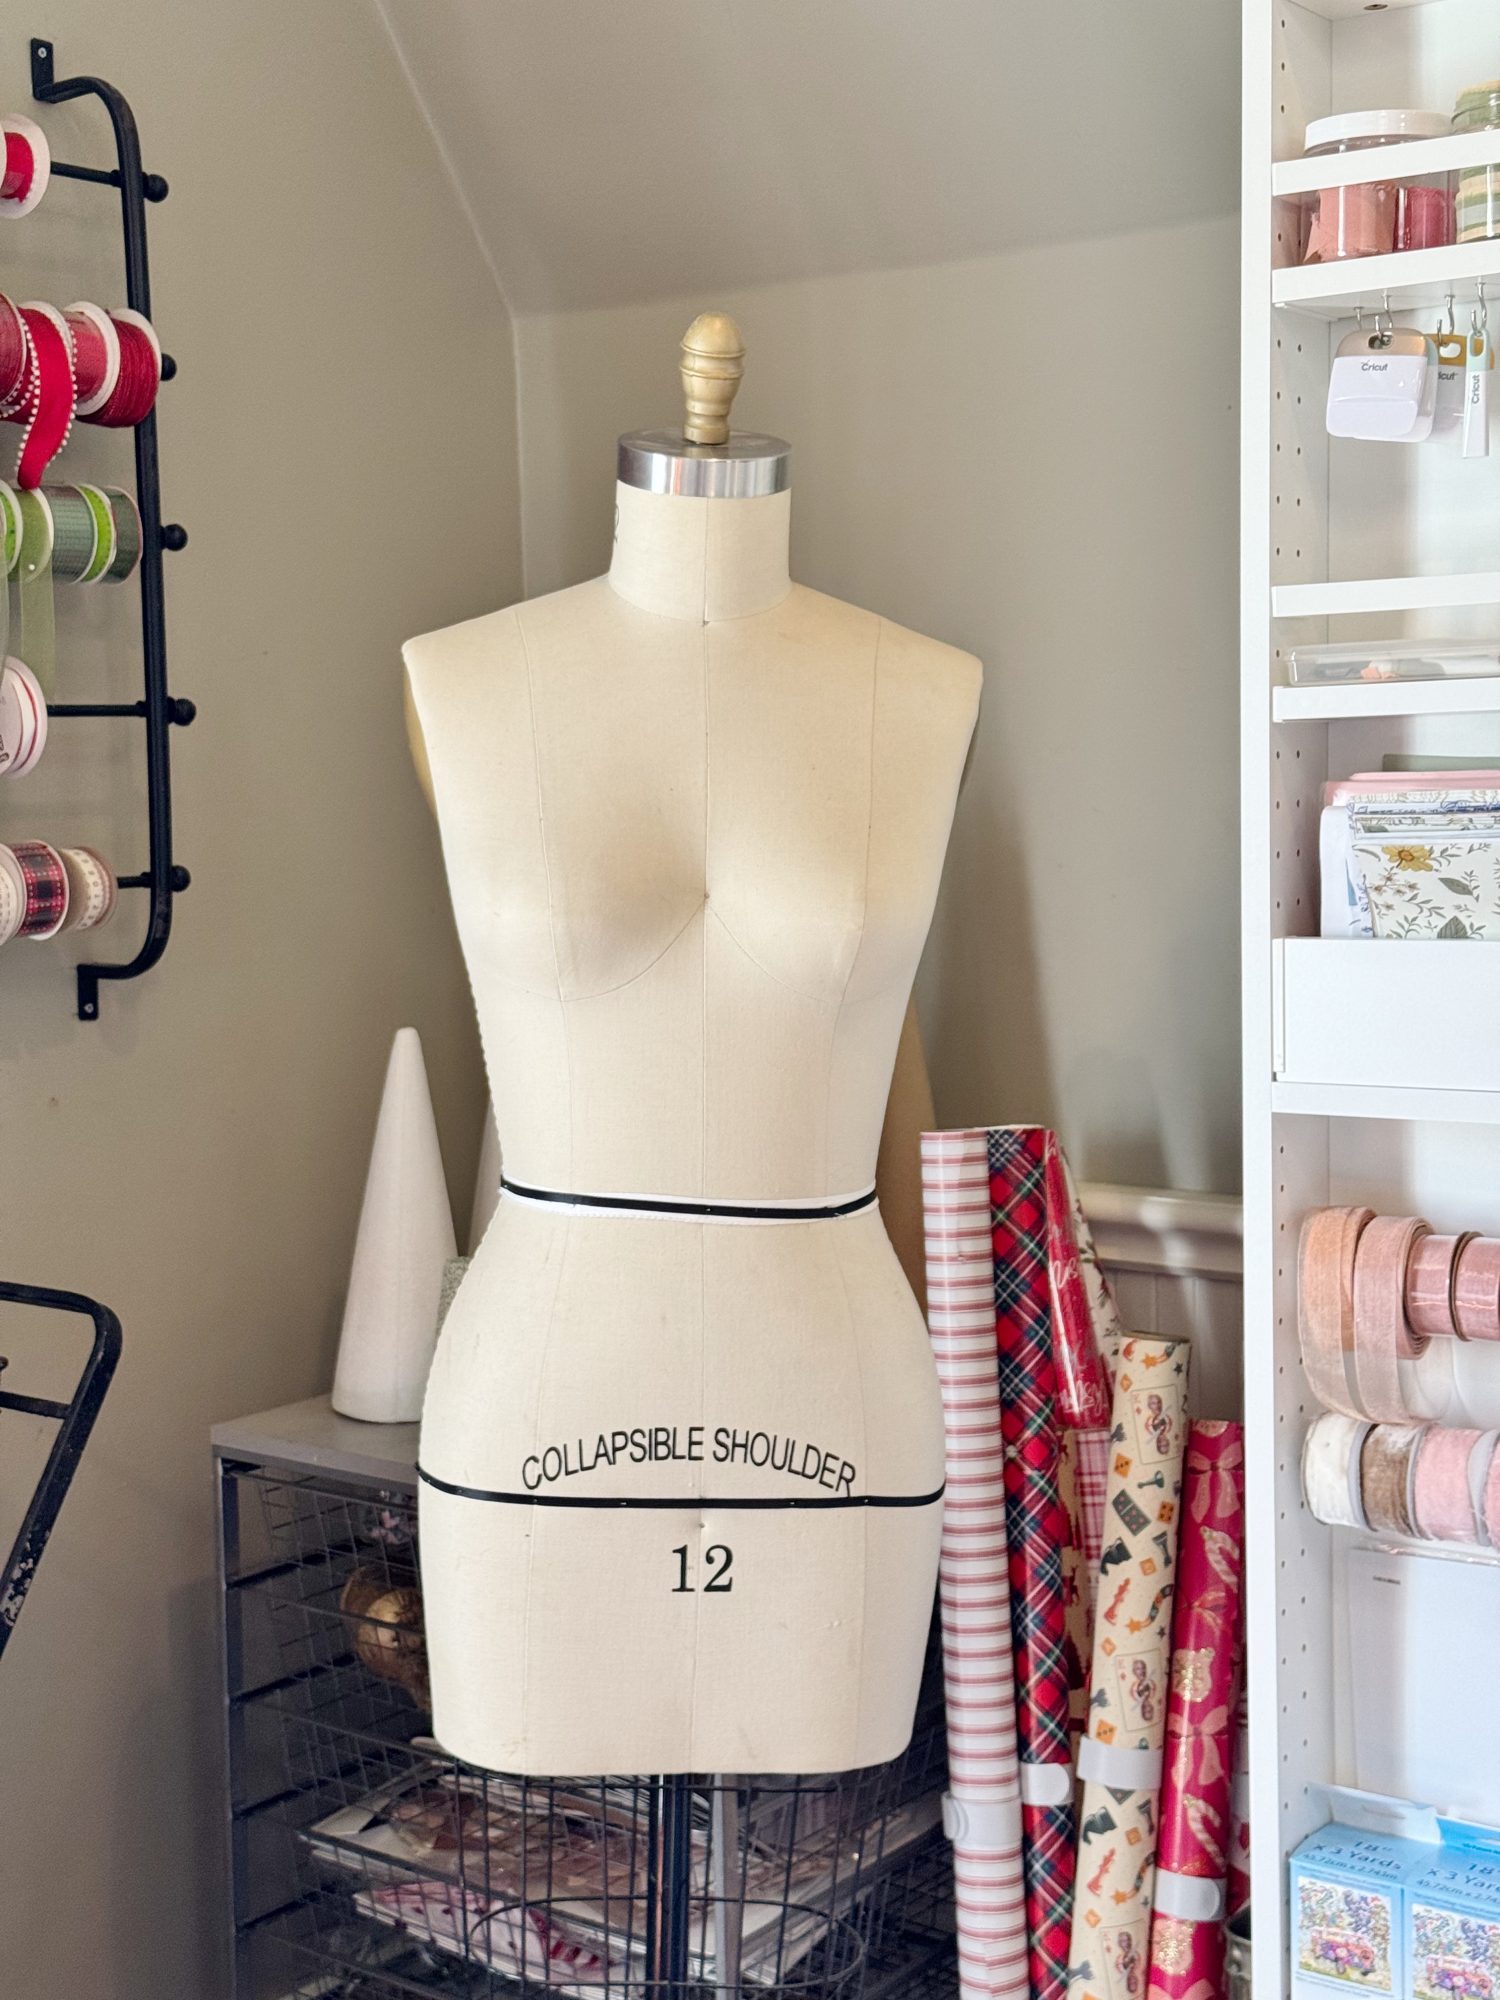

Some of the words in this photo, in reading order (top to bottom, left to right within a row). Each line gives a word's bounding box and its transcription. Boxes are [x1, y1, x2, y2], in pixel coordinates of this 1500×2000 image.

[1361, 360, 1389, 372] Cricut
[1437, 371, 1456, 381] icut
[1471, 374, 1481, 404] Cricut
[522, 1427, 704, 1490] COLLAPSIBLE
[713, 1428, 856, 1498] SHOULDER
[671, 1544, 734, 1593] 12
[1329, 1846, 1345, 1855] 3
[1349, 1850, 1402, 1870] Yards
[1444, 1870, 1458, 1880] 3
[1416, 1879, 1463, 1895] 45.72cm
